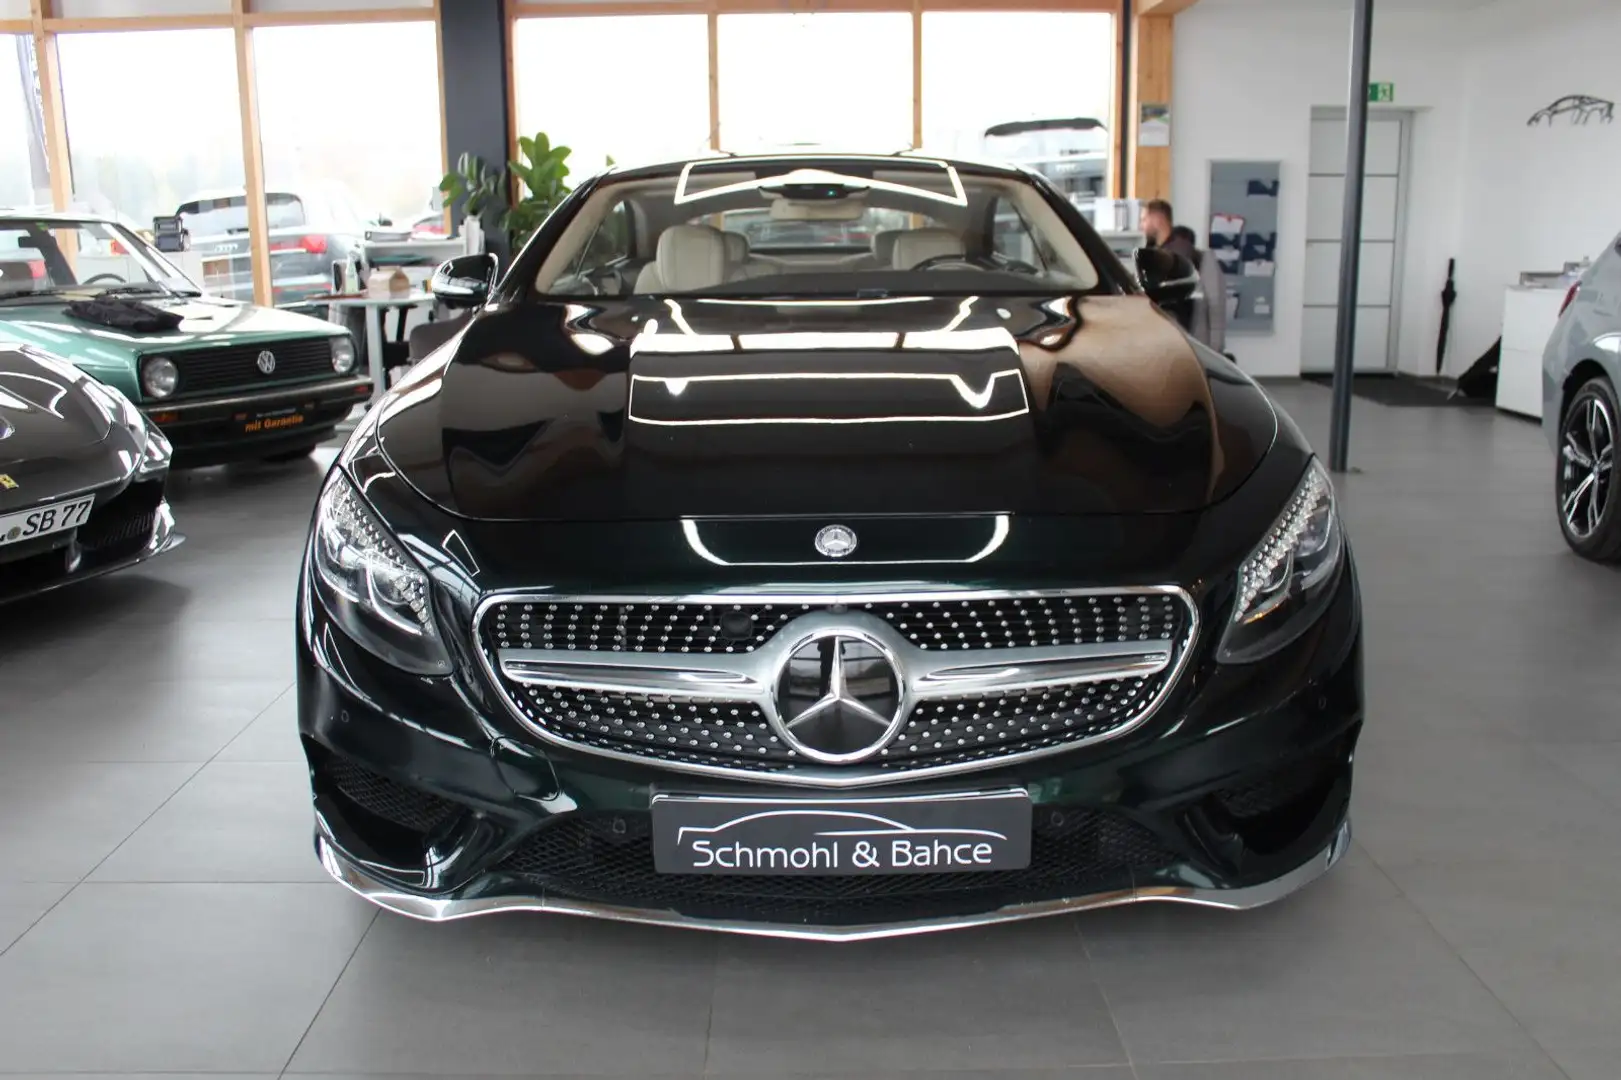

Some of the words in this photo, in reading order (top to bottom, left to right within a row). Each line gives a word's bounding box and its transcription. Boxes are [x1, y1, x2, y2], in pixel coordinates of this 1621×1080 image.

[22, 509, 57, 536] SB
[60, 501, 92, 527] 77
[692, 840, 839, 868] Schmohl
[852, 840, 880, 868] &
[891, 839, 993, 867] Bahce
